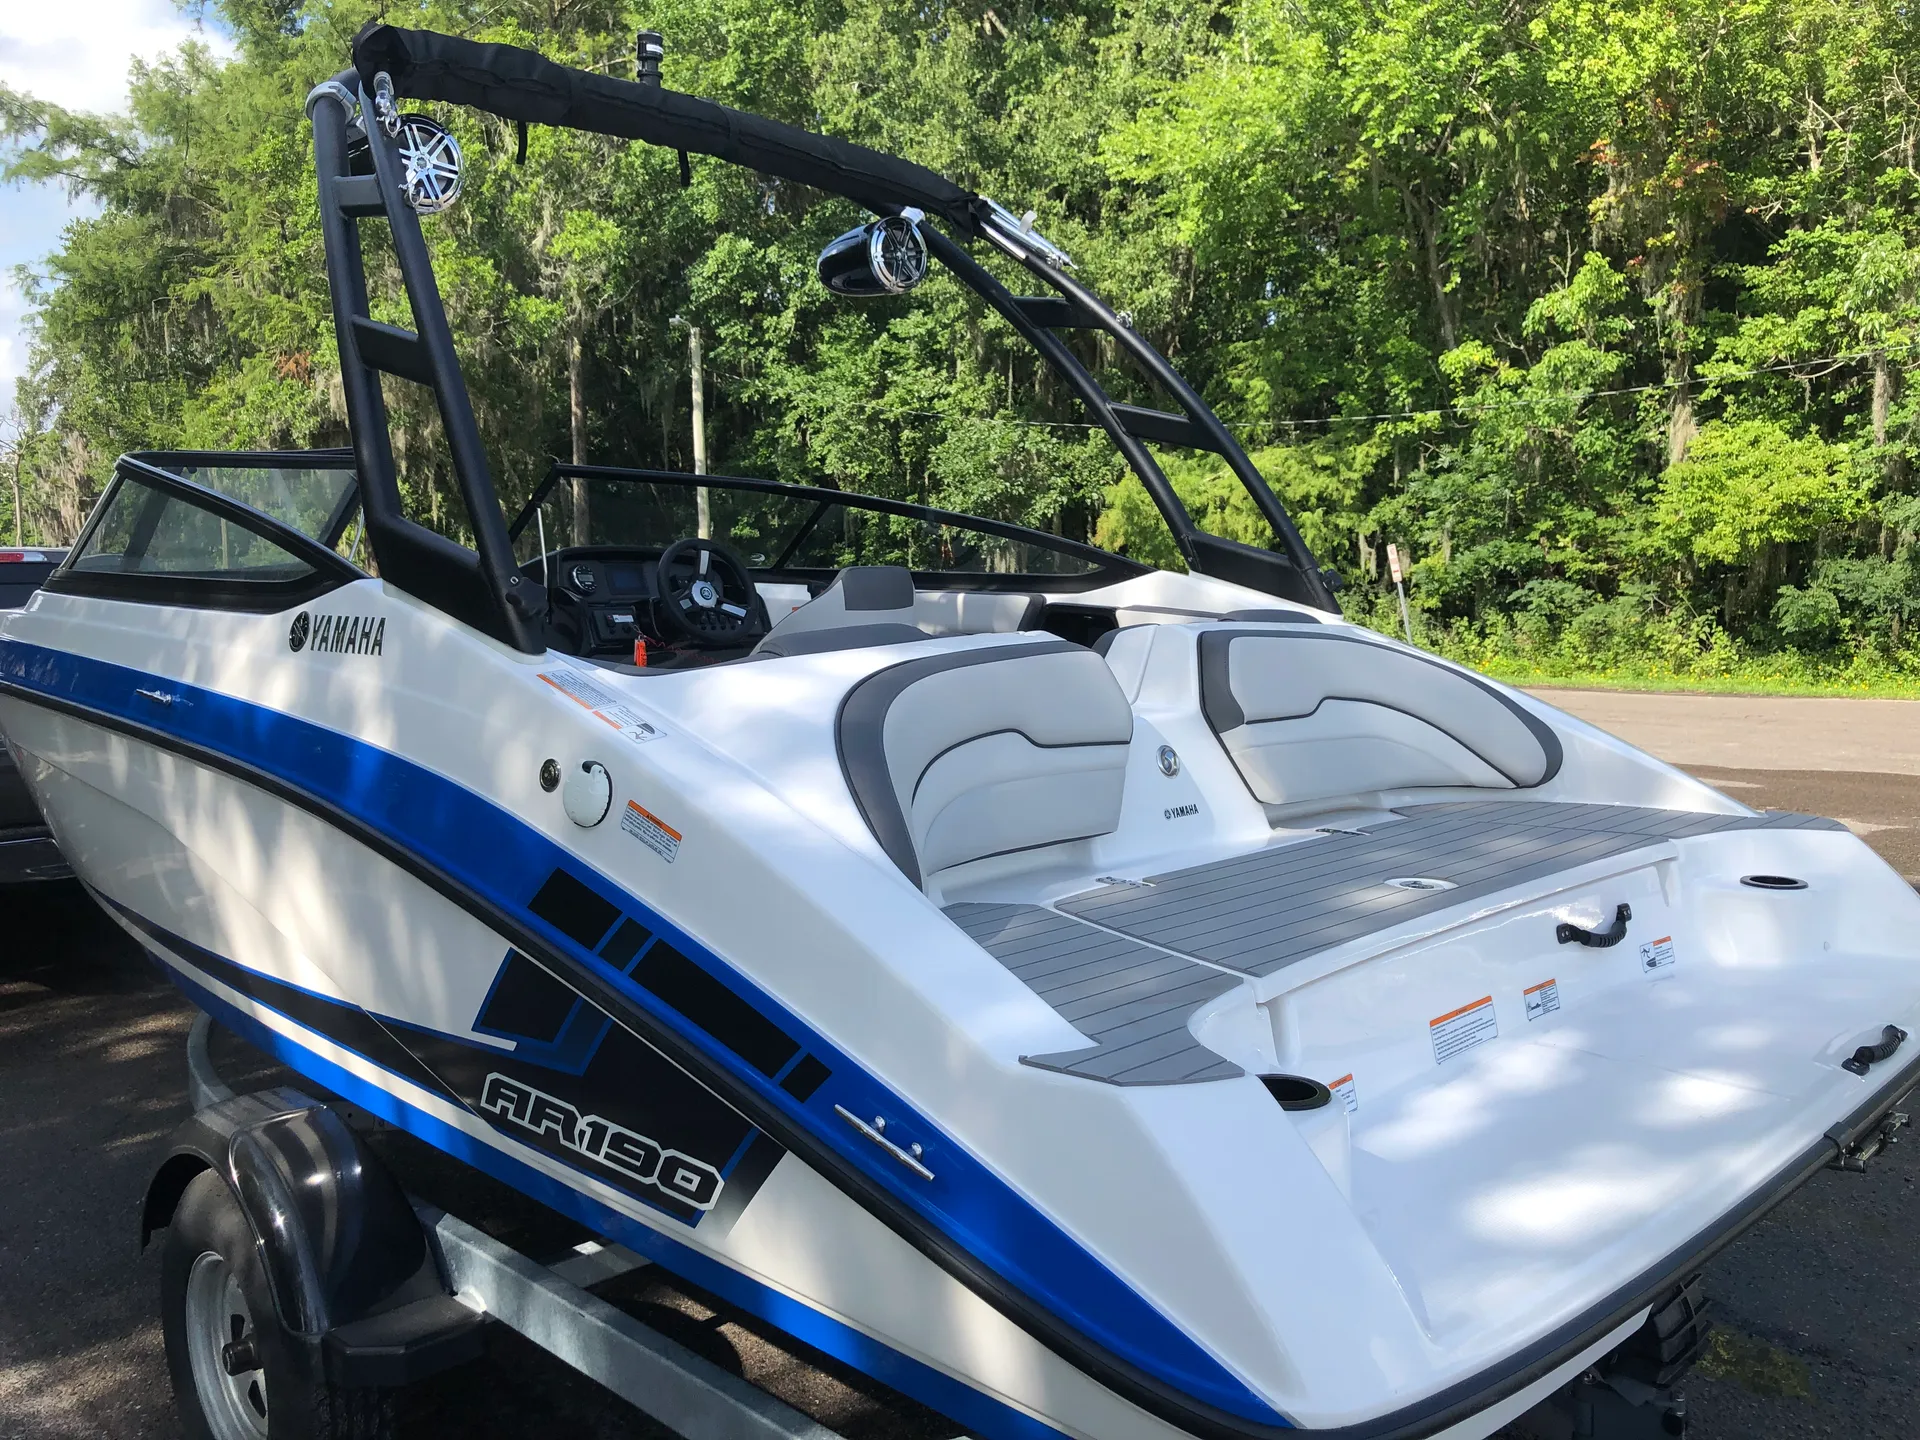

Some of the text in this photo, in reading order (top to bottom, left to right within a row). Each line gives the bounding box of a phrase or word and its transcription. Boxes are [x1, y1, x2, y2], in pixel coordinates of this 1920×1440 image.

[310, 614, 386, 656] YAMAHA
[1171, 803, 1199, 819] YAMAHA
[480, 1071, 725, 1211] AR190
